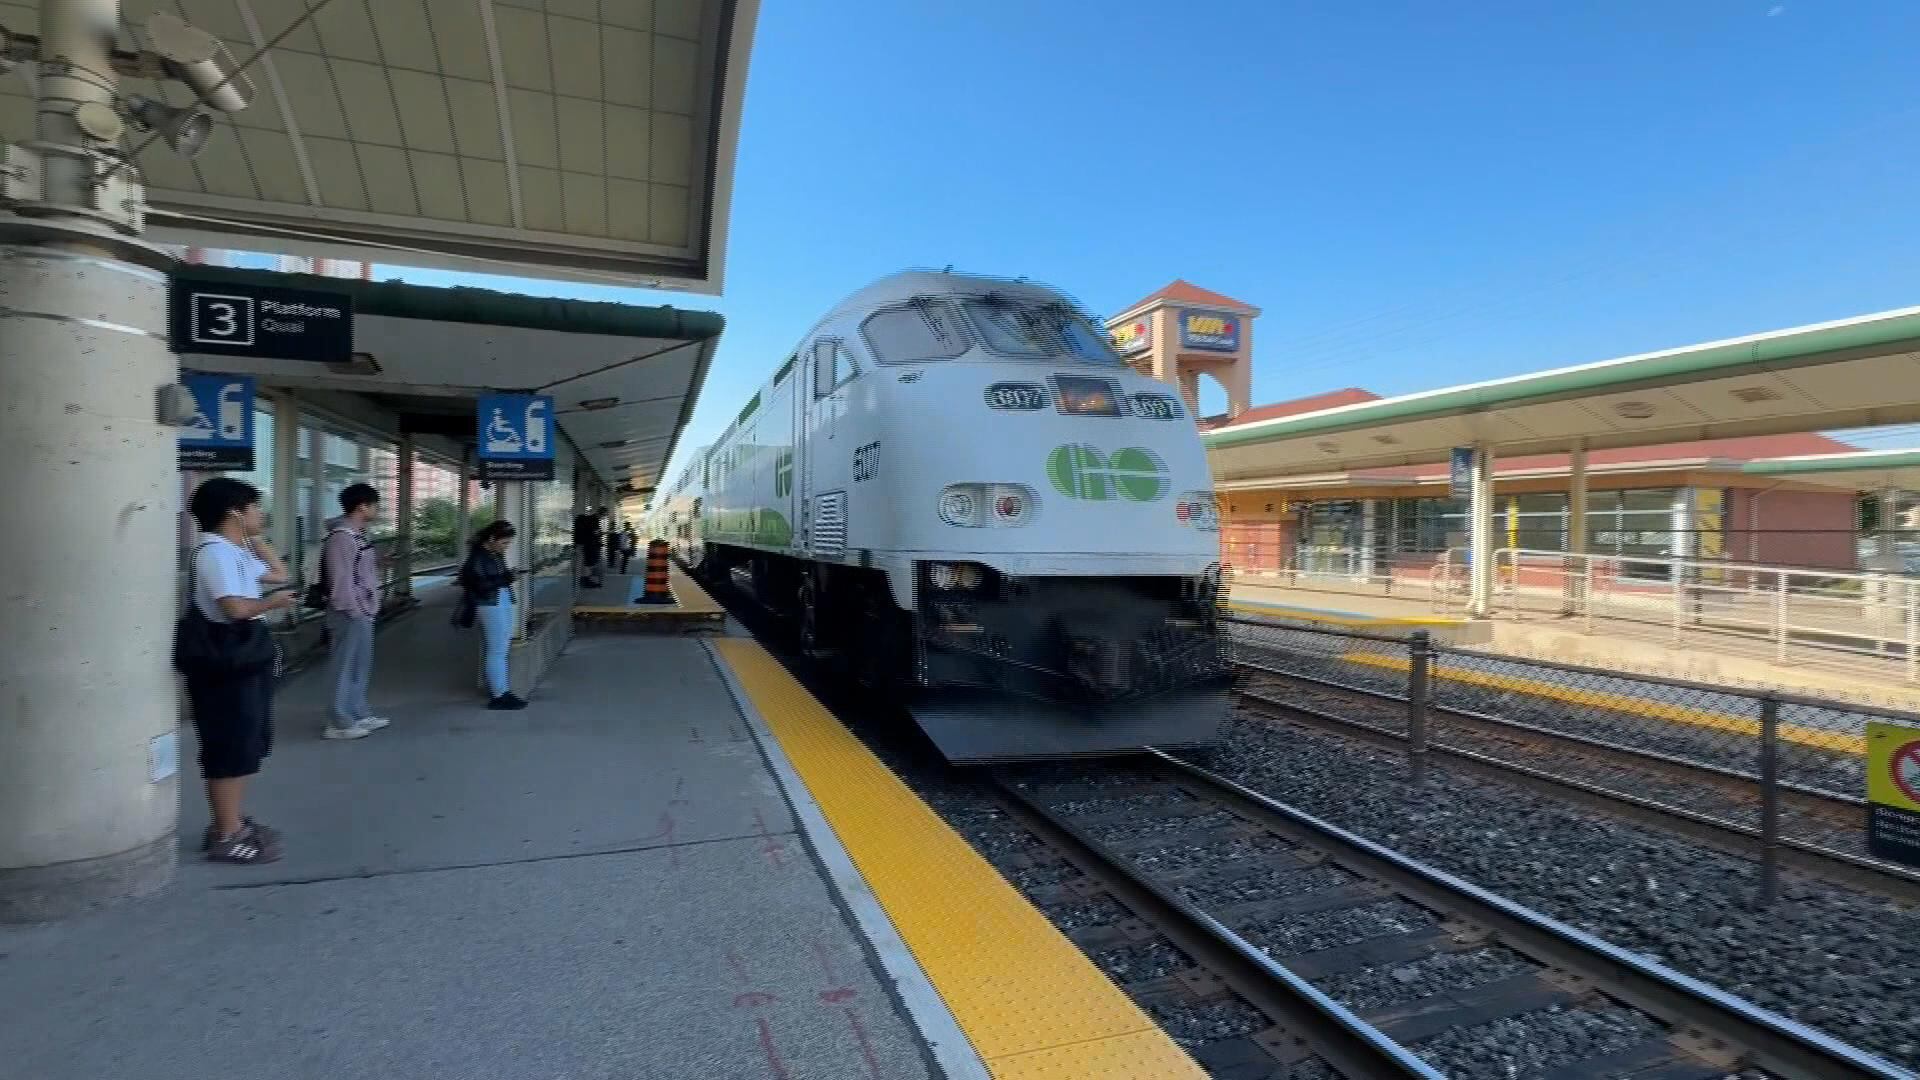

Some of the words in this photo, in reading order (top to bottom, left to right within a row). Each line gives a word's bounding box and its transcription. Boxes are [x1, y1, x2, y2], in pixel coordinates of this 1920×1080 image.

[209, 303, 238, 336] 3
[262, 301, 341, 319] Platform
[261, 320, 305, 334] Quai
[991, 387, 1042, 408] 607
[1131, 397, 1175, 418] 607
[853, 440, 881, 483] 607
